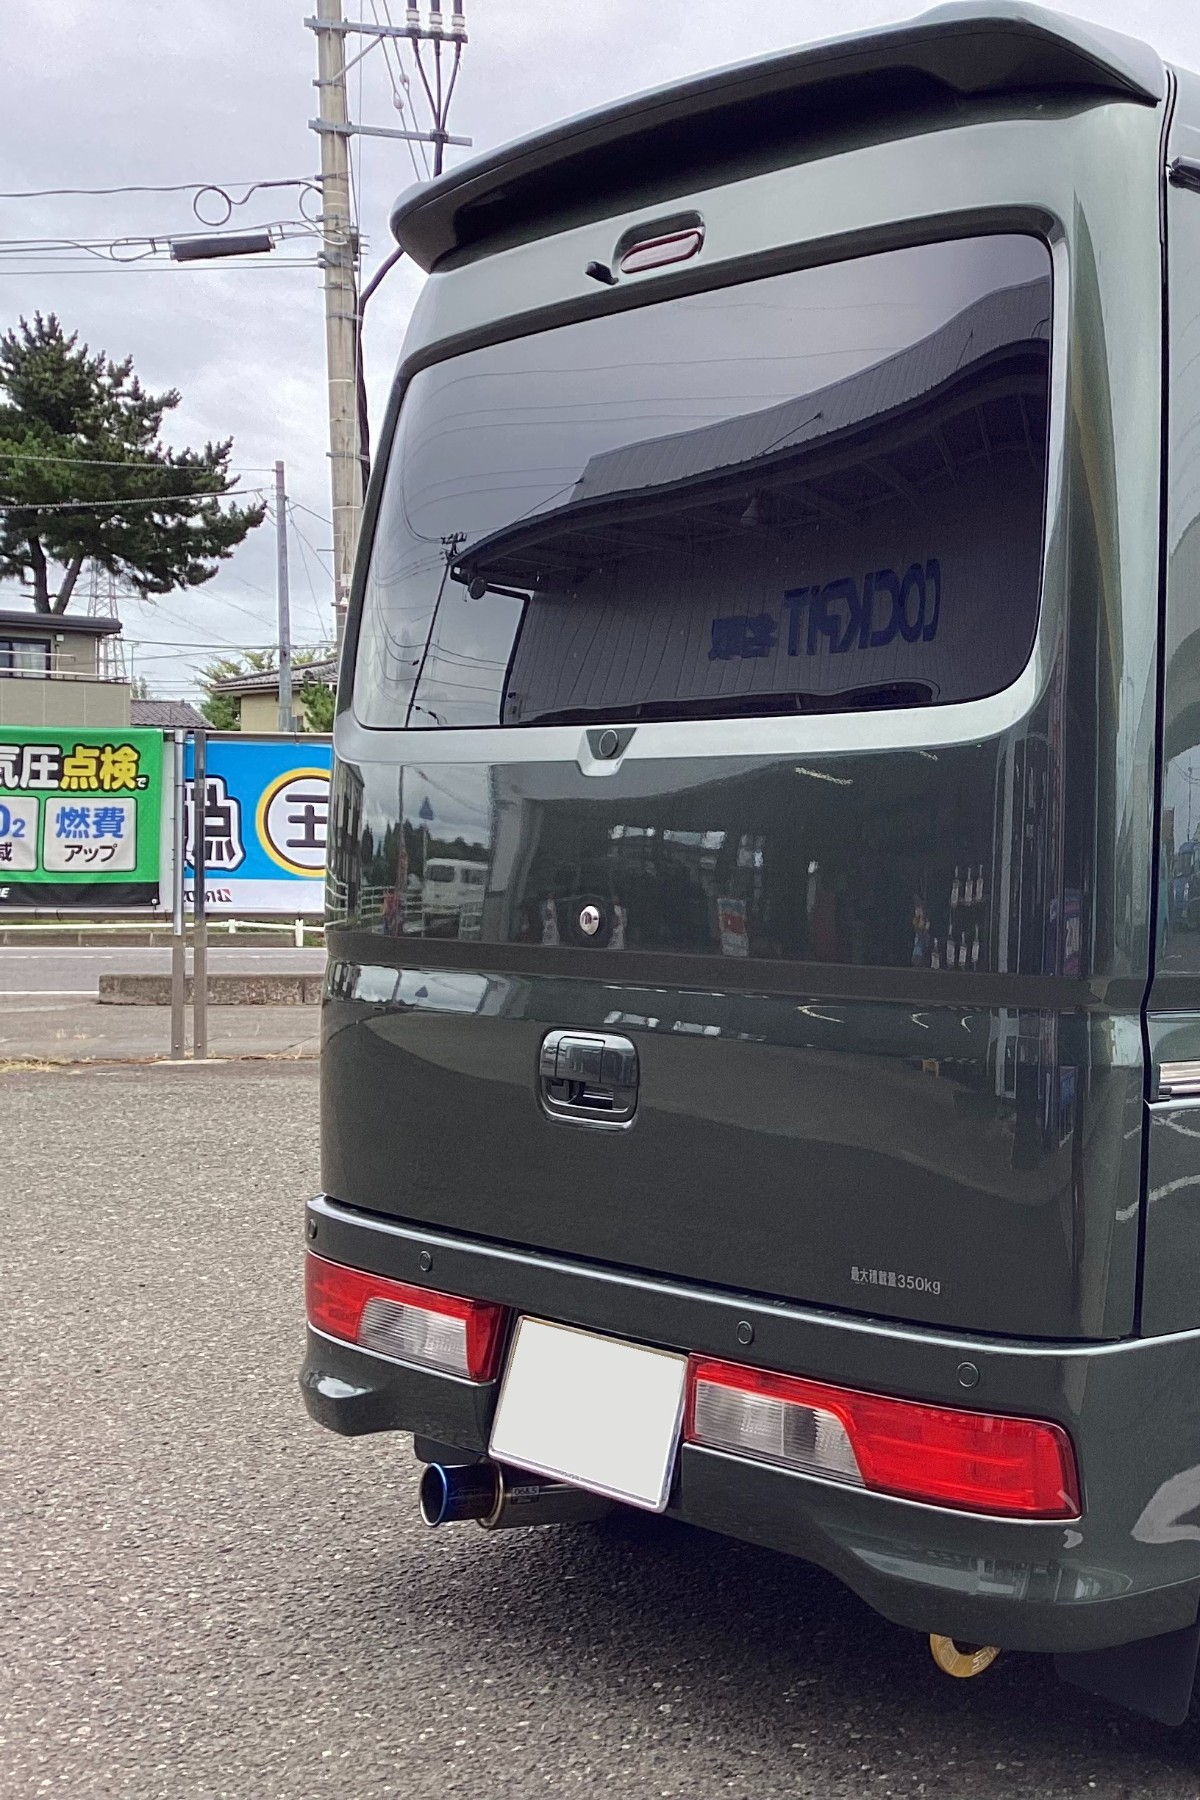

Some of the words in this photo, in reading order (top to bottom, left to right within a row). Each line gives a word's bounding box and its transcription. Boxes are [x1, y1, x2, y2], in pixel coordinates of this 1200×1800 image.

[55, 807, 125, 839] 燃費
[65, 843, 118, 863] アップ
